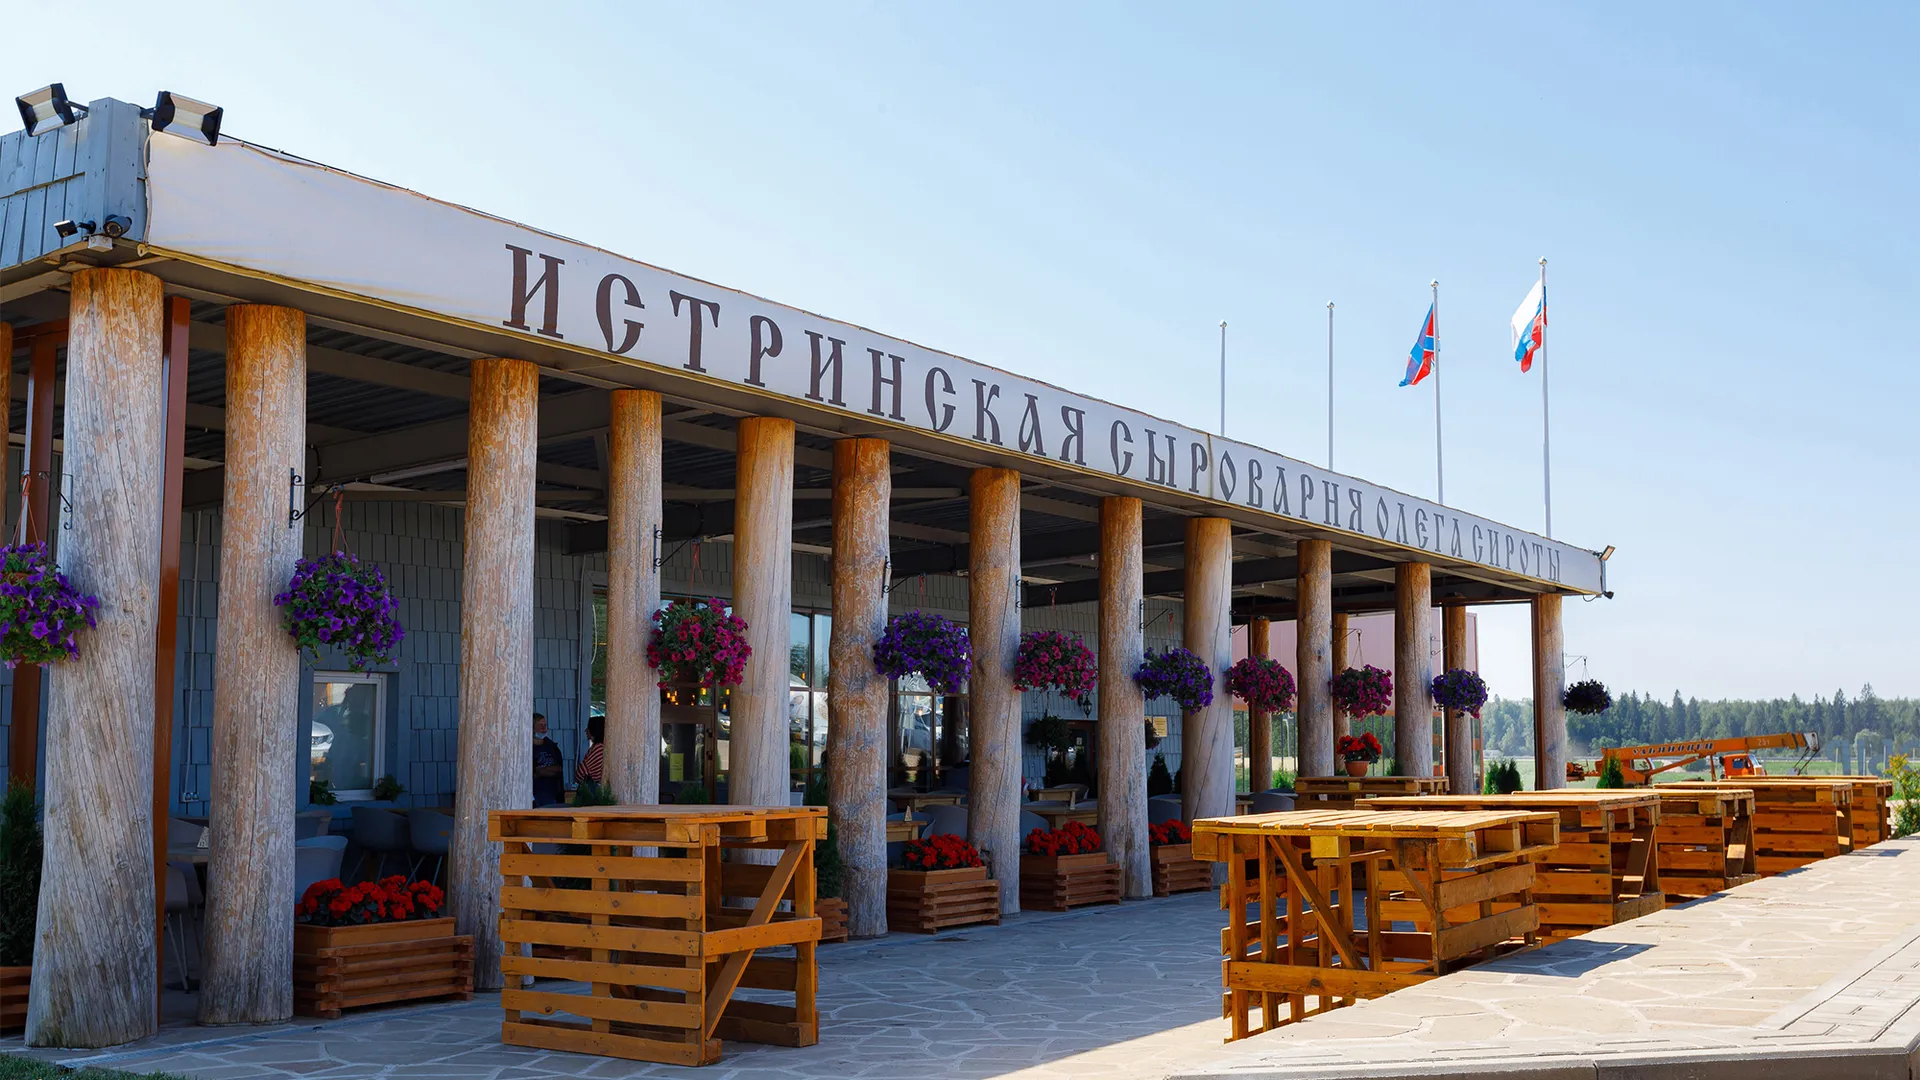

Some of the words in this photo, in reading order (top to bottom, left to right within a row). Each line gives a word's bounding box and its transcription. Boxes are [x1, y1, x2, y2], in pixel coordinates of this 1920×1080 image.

[502, 243, 1086, 466] ИСТРИНСКАЯ
[1109, 419, 1364, 534] СЫРОВАРНЯ
[1376, 496, 1463, 558] ОЛЕГА
[1472, 524, 1561, 583] СИРОТЫ
